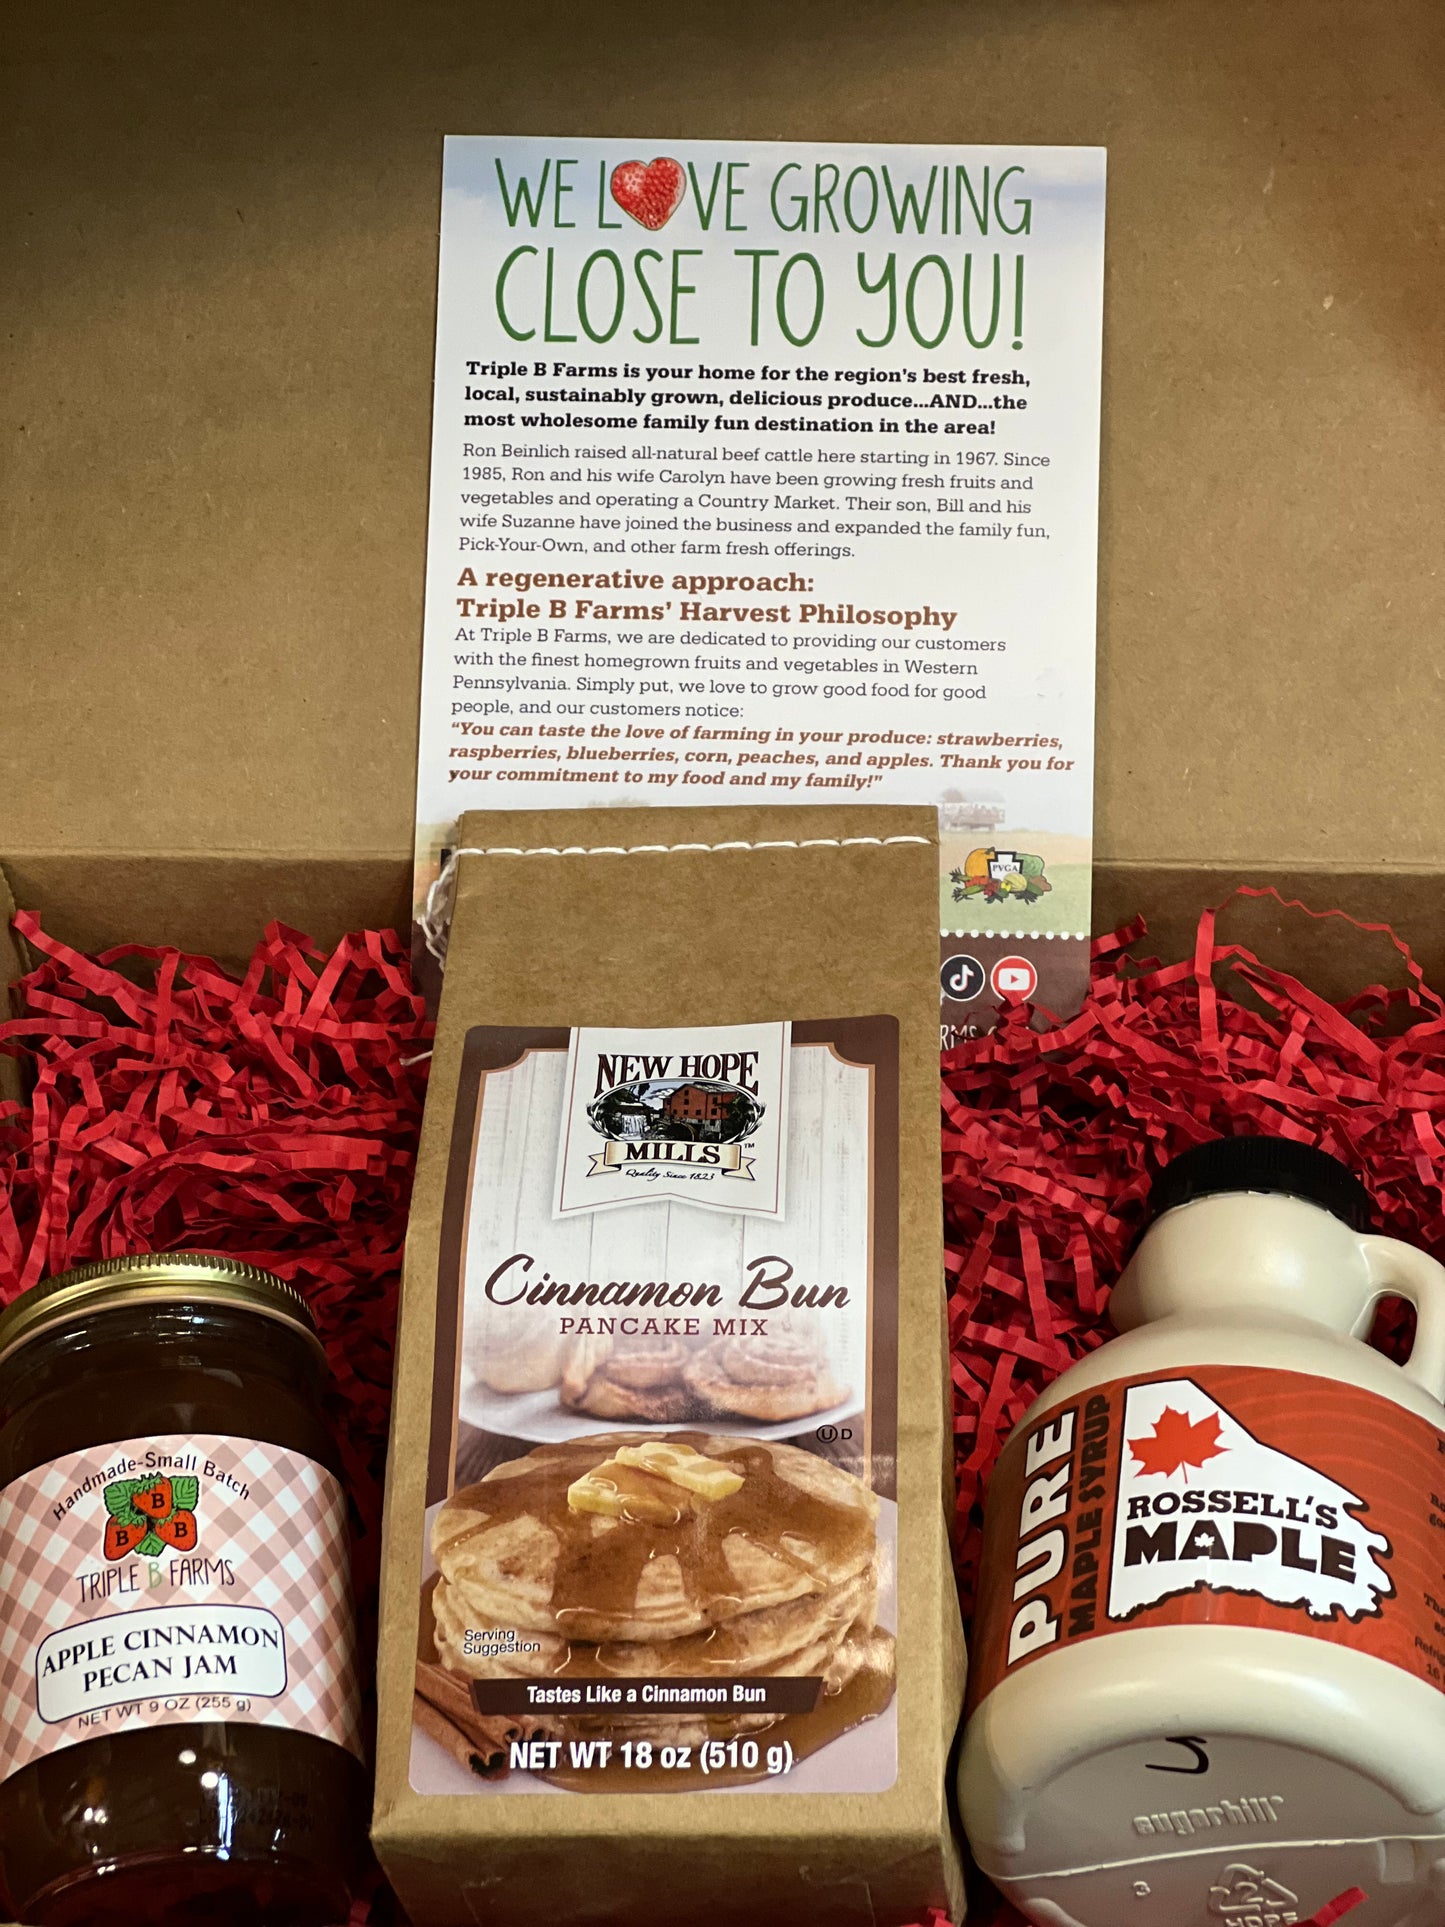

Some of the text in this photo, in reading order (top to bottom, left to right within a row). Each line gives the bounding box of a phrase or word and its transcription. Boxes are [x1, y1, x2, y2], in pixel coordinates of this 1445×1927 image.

[494, 157, 579, 229] WE
[770, 161, 1033, 236] GROWING
[495, 244, 1025, 350] CLOSE TO YOU!
[465, 360, 1030, 388] Triple B Farms is your home for the region's best fresh,
[464, 385, 520, 404] local,
[525, 387, 647, 407] sustainably
[650, 392, 724, 408] grown,
[729, 390, 823, 407] delicious
[463, 412, 996, 435] most wholesome family fun destination in the area!
[463, 443, 1050, 468] Ron Beinlich raised all-natural beef cattle here starting in 1967. Since
[459, 537, 855, 560] Pick-Your-Own, and other farm fresh offerings.
[457, 567, 814, 595] A regenerative approach:
[456, 598, 958, 631] Triple B Farms' Harvest Philosophy
[453, 651, 978, 675] with the finest homegrown fruits and vegetables in Western
[453, 675, 987, 701] Pennsylvania. Simply put, we love to grow good food for good
[451, 699, 744, 718] people, and our customers notice:
[499, 726, 533, 736] can
[538, 724, 586, 737] taste
[591, 723, 621, 738] the
[625, 724, 665, 739] love
[669, 725, 691, 739] of
[692, 725, 772, 744] farming
[774, 727, 794, 741] in
[798, 732, 844, 745] your
[846, 730, 932, 746] produce:
[936, 732, 1063, 750] strawberries,
[448, 769, 493, 783] your
[496, 768, 620, 783] commitment
[624, 770, 643, 783] to
[647, 773, 679, 787] my
[681, 770, 726, 785] food
[729, 772, 767, 786] and
[770, 776, 802, 790] my
[992, 863, 1019, 873] PVGA
[594, 1051, 759, 1099] NEW HOPE
[624, 1142, 721, 1164] MILLS
[625, 1167, 715, 1182] Quality Since 1823
[484, 1253, 851, 1310] Cinnamon Bun
[559, 1317, 769, 1336] PANCAKE MIX
[203, 1460, 251, 1501] Batch
[151, 1493, 165, 1508] B
[1126, 1490, 1338, 1529] ROSSELL'S
[1068, 1394, 1112, 1638] MAPLE SYRUP
[115, 1521, 188, 1546] B B
[1006, 1406, 1080, 1667] PURE
[1124, 1520, 1357, 1584] MAPLE
[76, 1558, 236, 1603] TRIPLE B FARMS
[463, 1640, 541, 1655] Suggestion
[464, 1628, 515, 1643] Serving
[41, 1624, 280, 1678] APPLE CINNAMON
[83, 1654, 238, 1693] PECAN JAM
[527, 1685, 766, 1703] Tastes Like a Cinnamon Bun
[77, 1696, 252, 1728] NET WT 9 OZ (255 g)
[509, 1741, 793, 1774] NET WT 18 oz (510 g)
